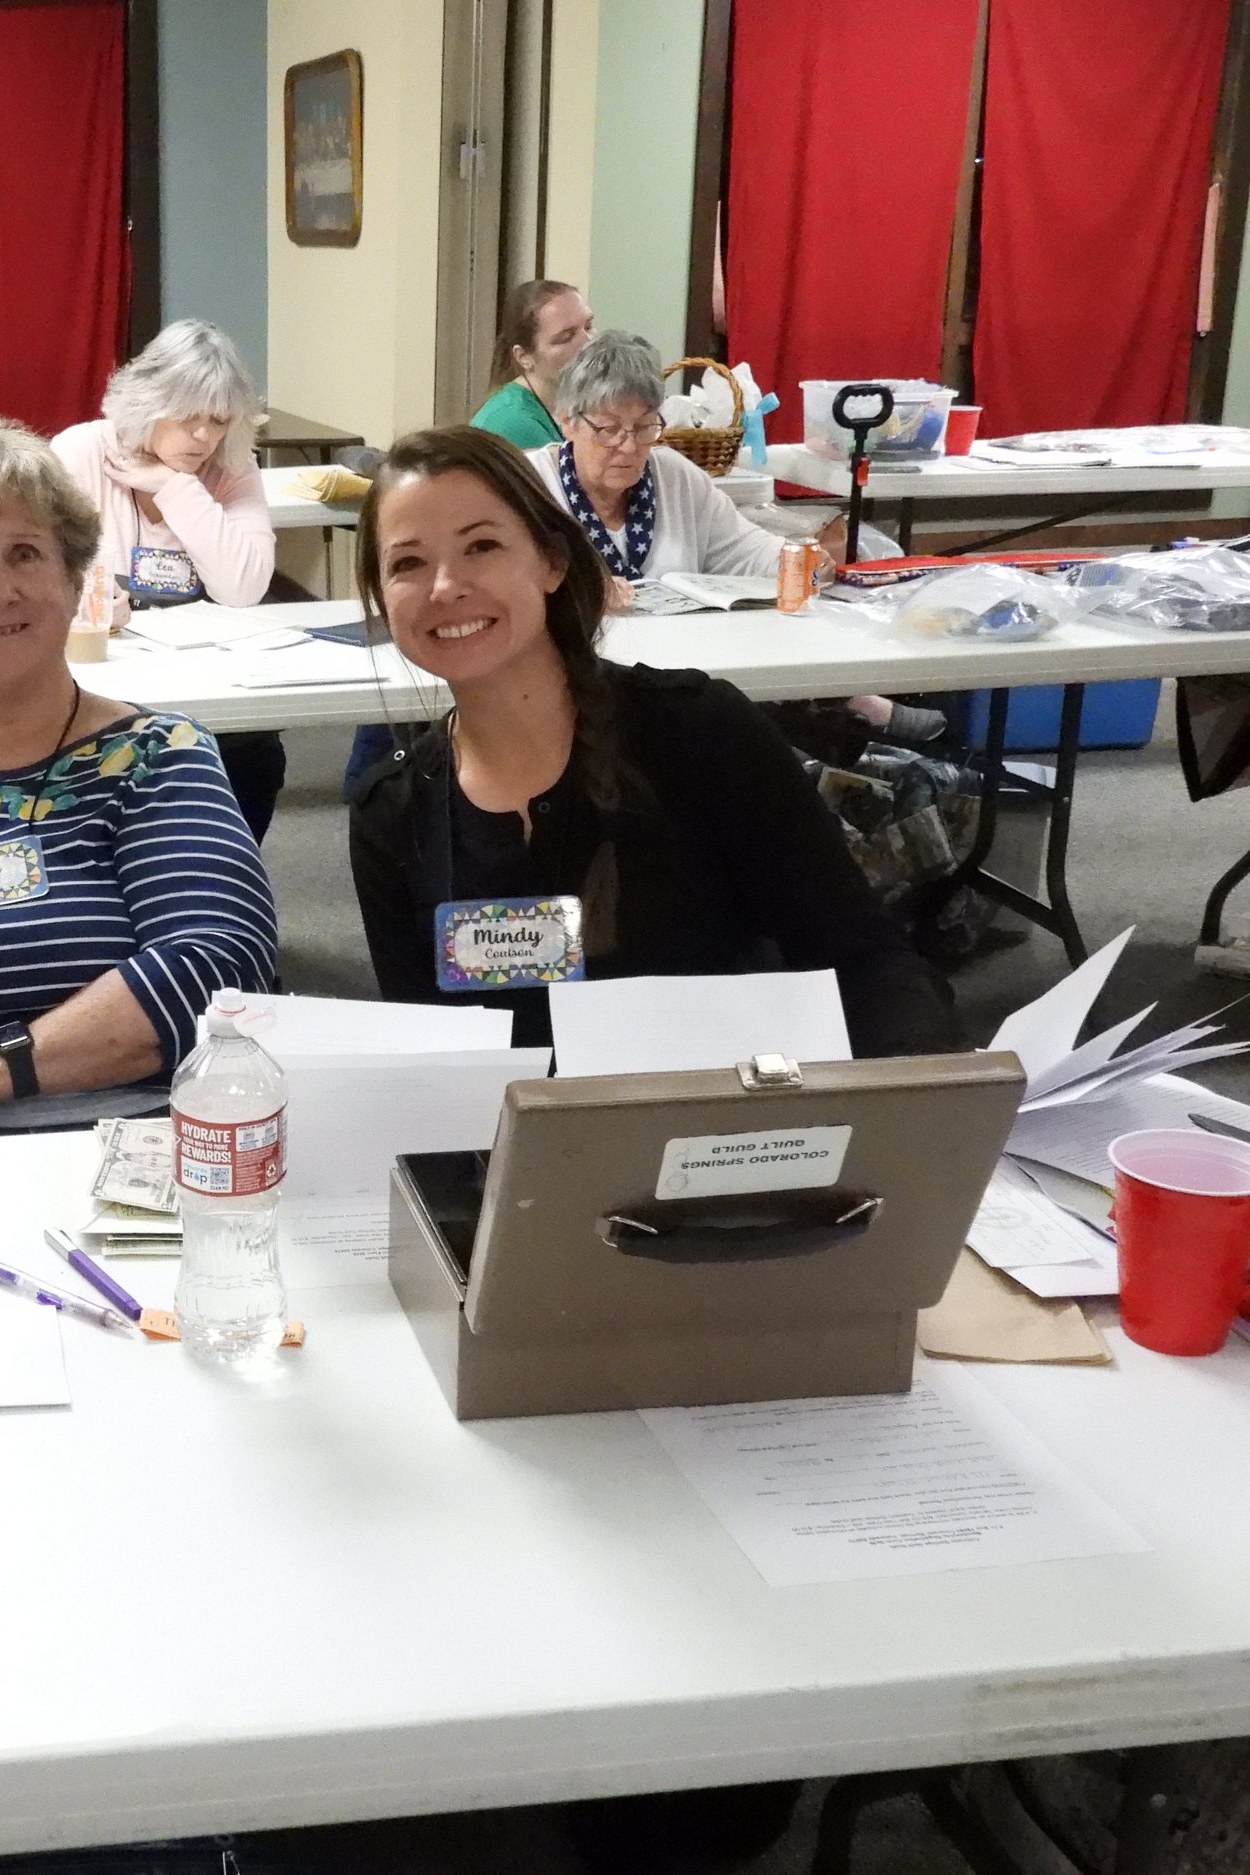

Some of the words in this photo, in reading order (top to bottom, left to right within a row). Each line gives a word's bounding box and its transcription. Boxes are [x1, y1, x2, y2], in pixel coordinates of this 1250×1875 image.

[473, 927, 544, 947] Mindy
[485, 948, 534, 959] Coulson
[181, 1120, 232, 1143] HYDRATE
[711, 1143, 756, 1154] GUILD
[760, 1139, 806, 1150] QUILT
[181, 1141, 232, 1163] REWARDS!
[750, 1150, 829, 1164] COLORADO
[681, 1157, 745, 1170] SPRINGS
